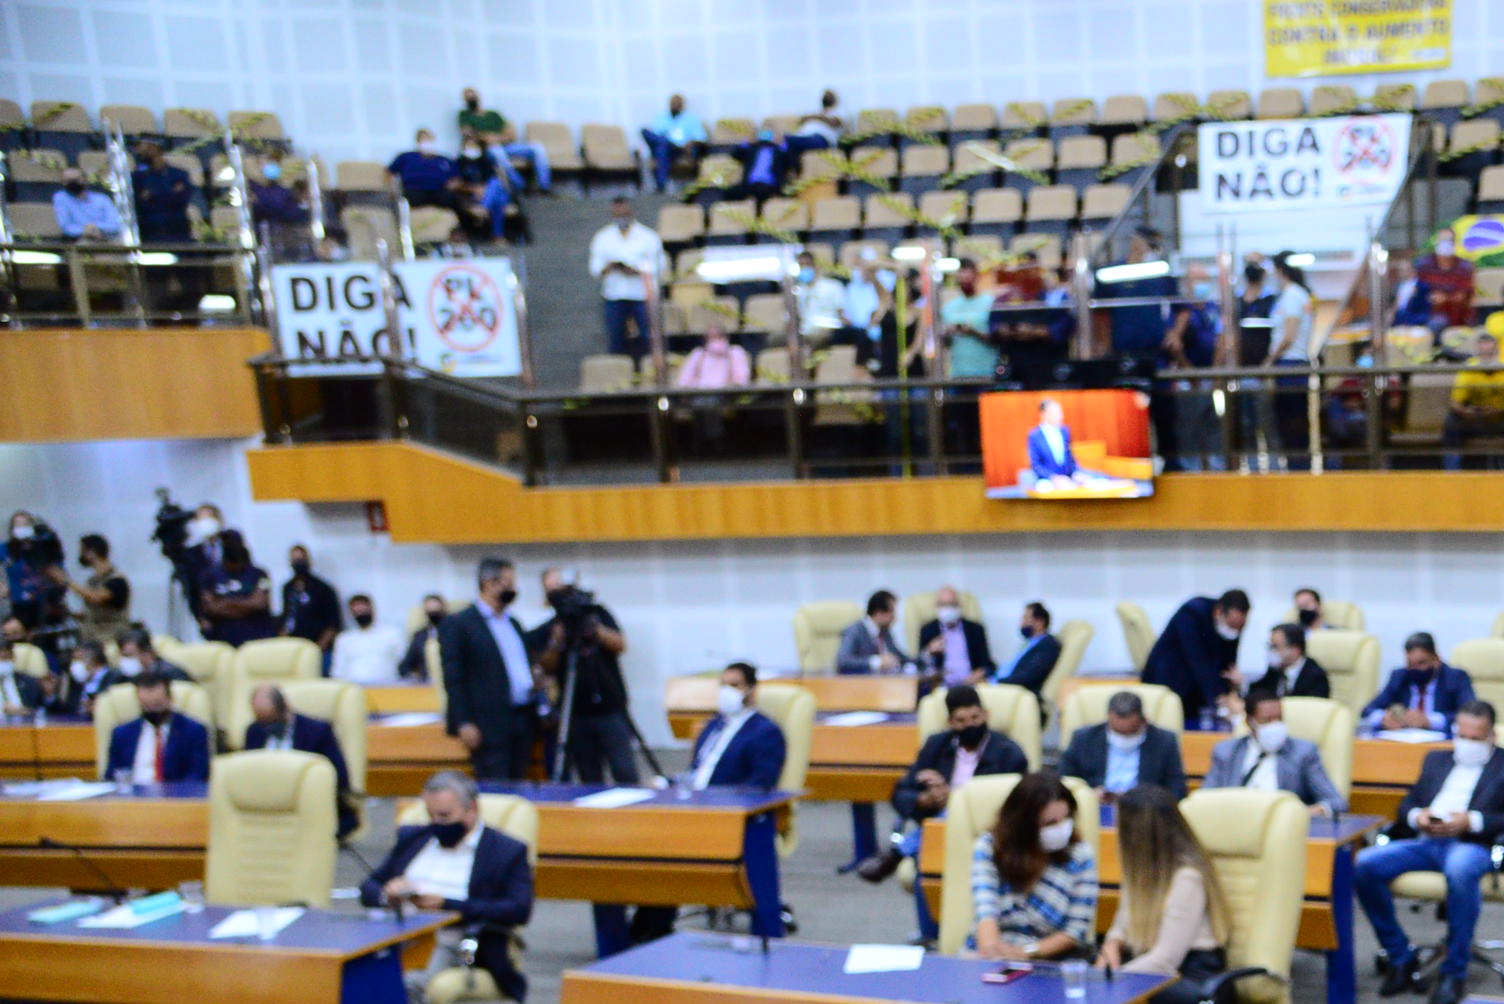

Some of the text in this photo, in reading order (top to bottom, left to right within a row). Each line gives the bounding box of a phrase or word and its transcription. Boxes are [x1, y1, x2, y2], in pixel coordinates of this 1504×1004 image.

[1217, 127, 1320, 158] DIGA
[1217, 165, 1320, 201] NÃO!
[289, 274, 412, 312] DIGA
